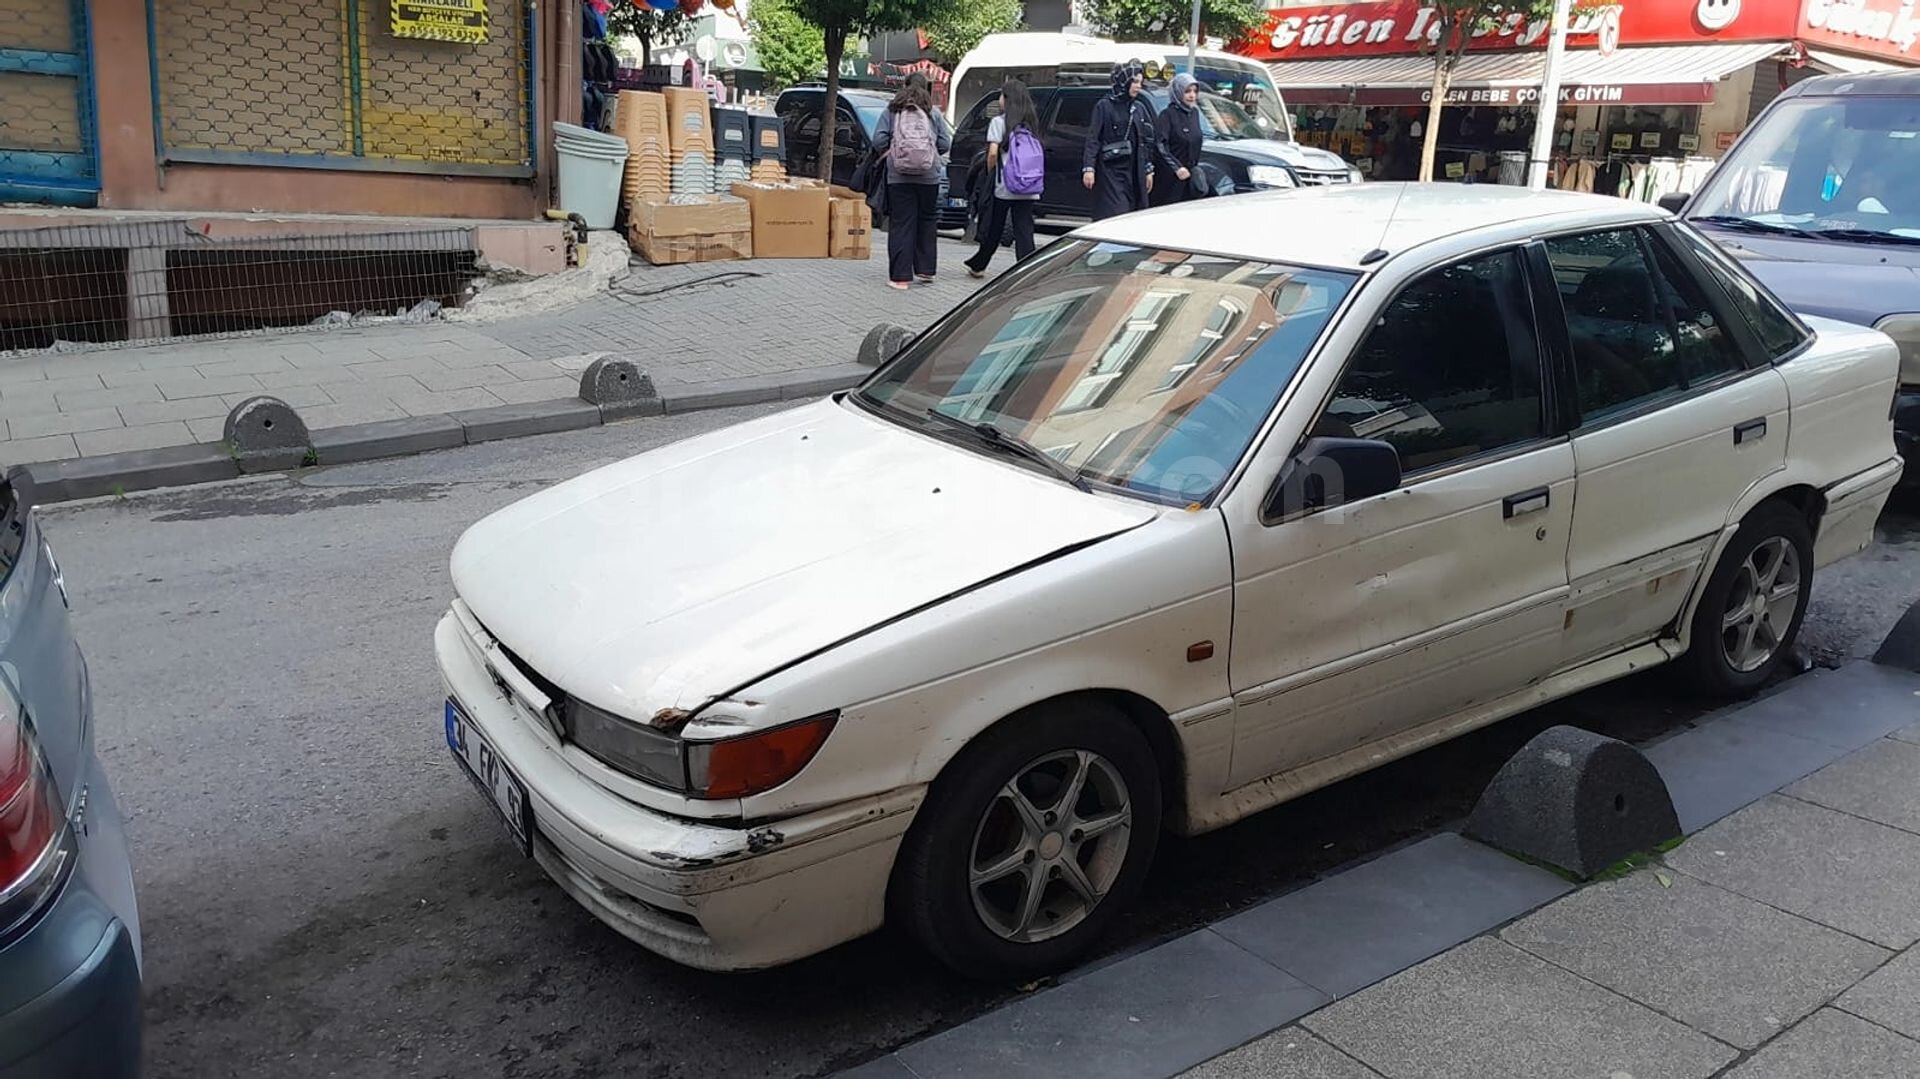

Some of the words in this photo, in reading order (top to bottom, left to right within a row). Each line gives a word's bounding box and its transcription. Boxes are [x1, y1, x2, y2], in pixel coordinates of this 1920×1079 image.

[1271, 10, 1395, 49] Gülen
[1421, 90, 1469, 102] GLEN
[1471, 89, 1510, 102] BEBE
[1574, 85, 1623, 101] GİYİM
[453, 714, 470, 761] 34
